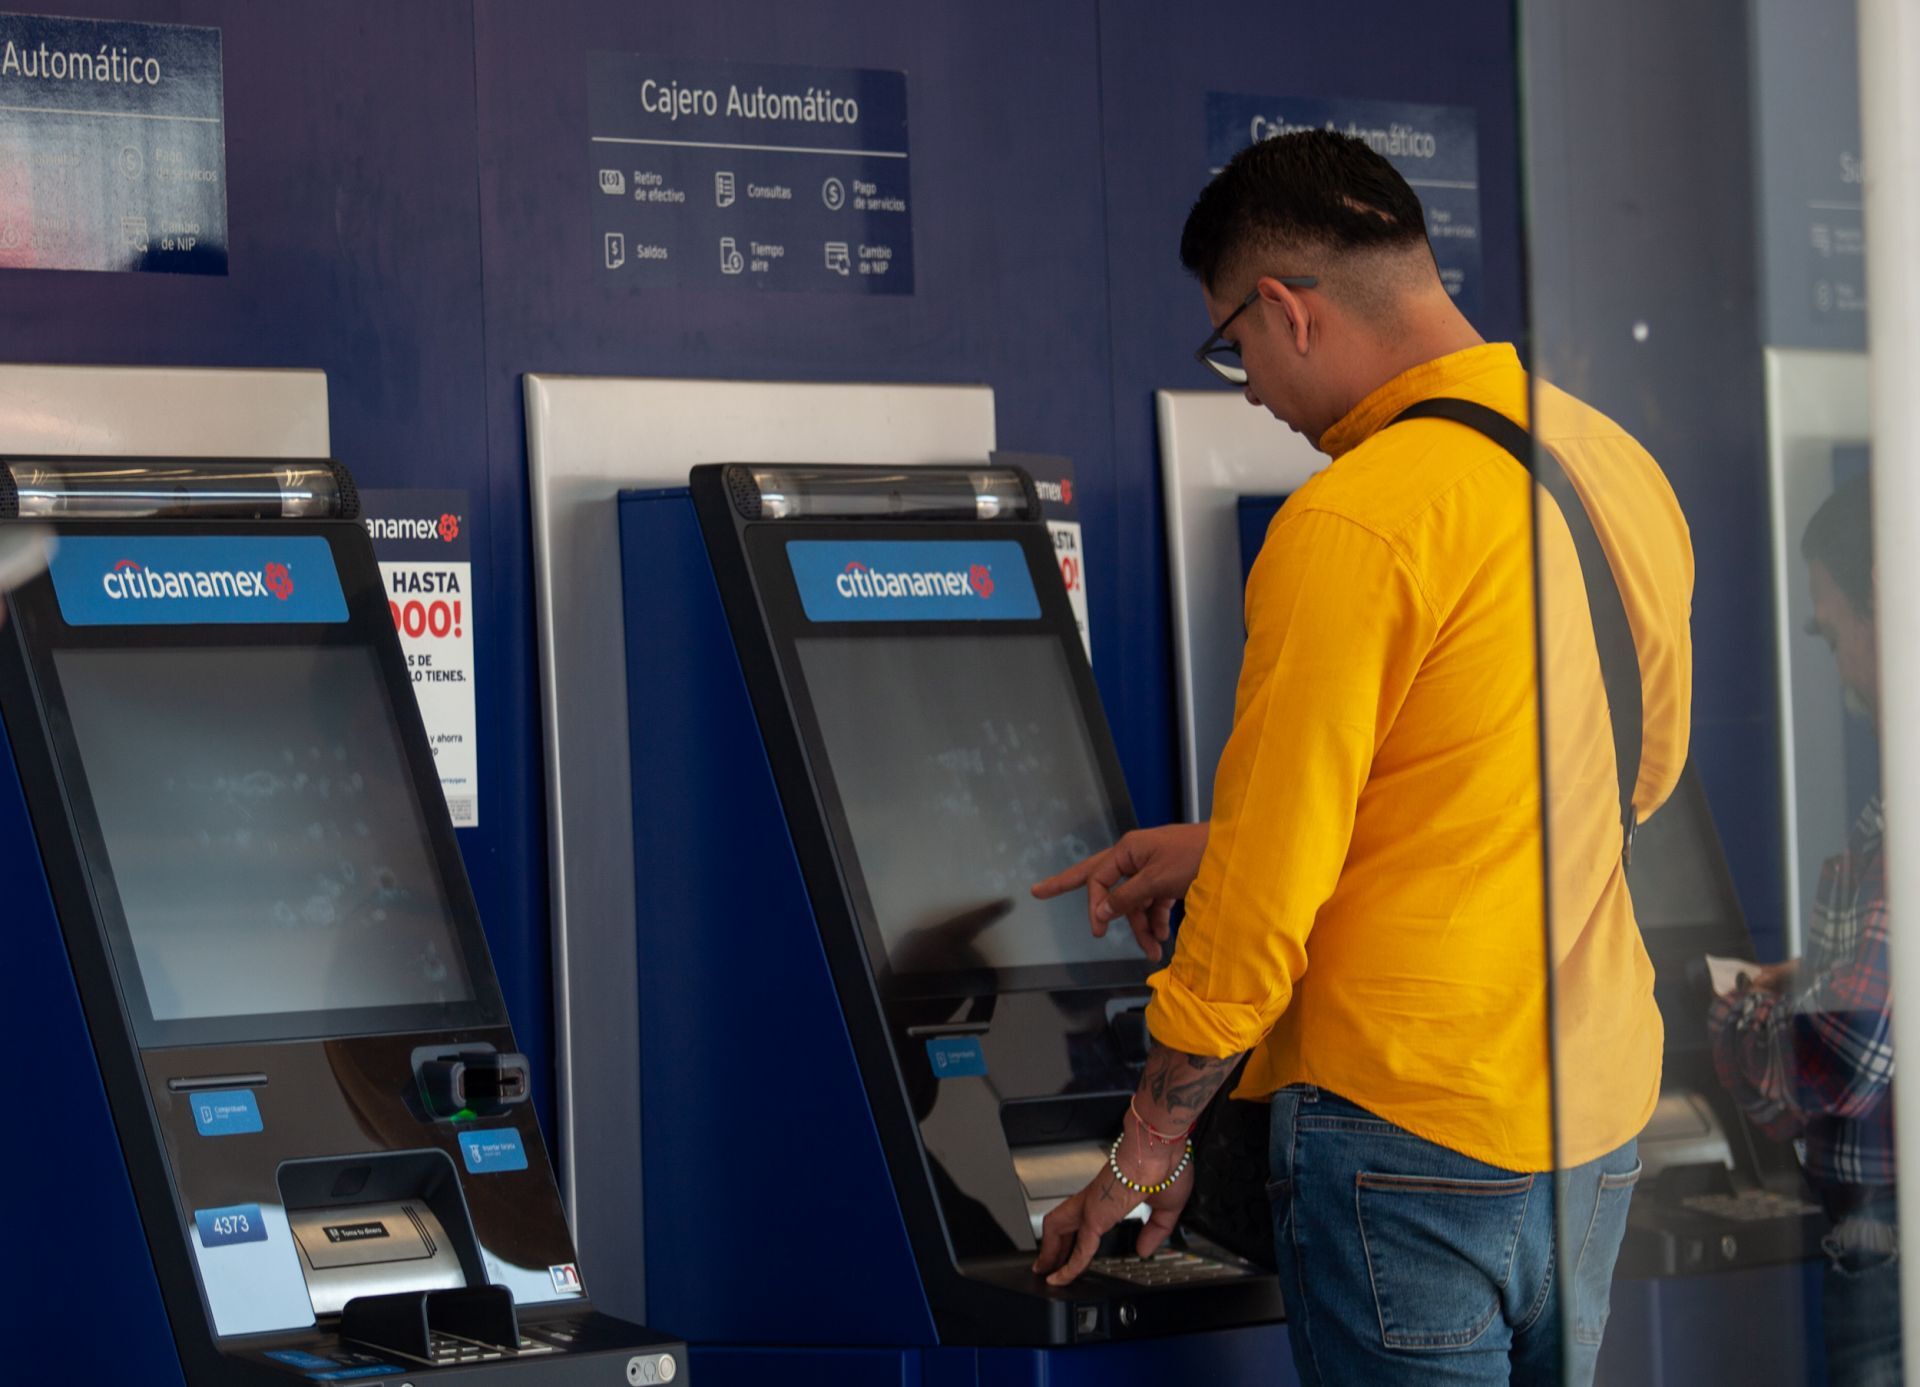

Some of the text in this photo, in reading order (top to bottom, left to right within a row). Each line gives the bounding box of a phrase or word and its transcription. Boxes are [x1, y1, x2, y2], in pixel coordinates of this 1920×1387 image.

[1, 40, 161, 85] Automático
[641, 79, 859, 124] Cajero Automático
[634, 171, 662, 186] Retiro
[635, 188, 685, 203] de efectivo
[747, 184, 792, 200] Consultas
[854, 180, 877, 196] Pago
[854, 197, 906, 213] de servicios
[161, 236, 196, 251] de NIP
[750, 242, 784, 258] Tiempo
[637, 244, 668, 260] Saldos
[859, 245, 892, 260] Cambio
[751, 258, 769, 272] aire
[859, 260, 889, 275] de NIP
[103, 559, 269, 599] citibanamex
[392, 571, 460, 593] HASTA
[836, 561, 974, 598] citibanamex
[418, 655, 432, 666] DE
[426, 670, 466, 682] TIENES.
[430, 734, 463, 744] y ahorra
[214, 1214, 249, 1235] 4373
